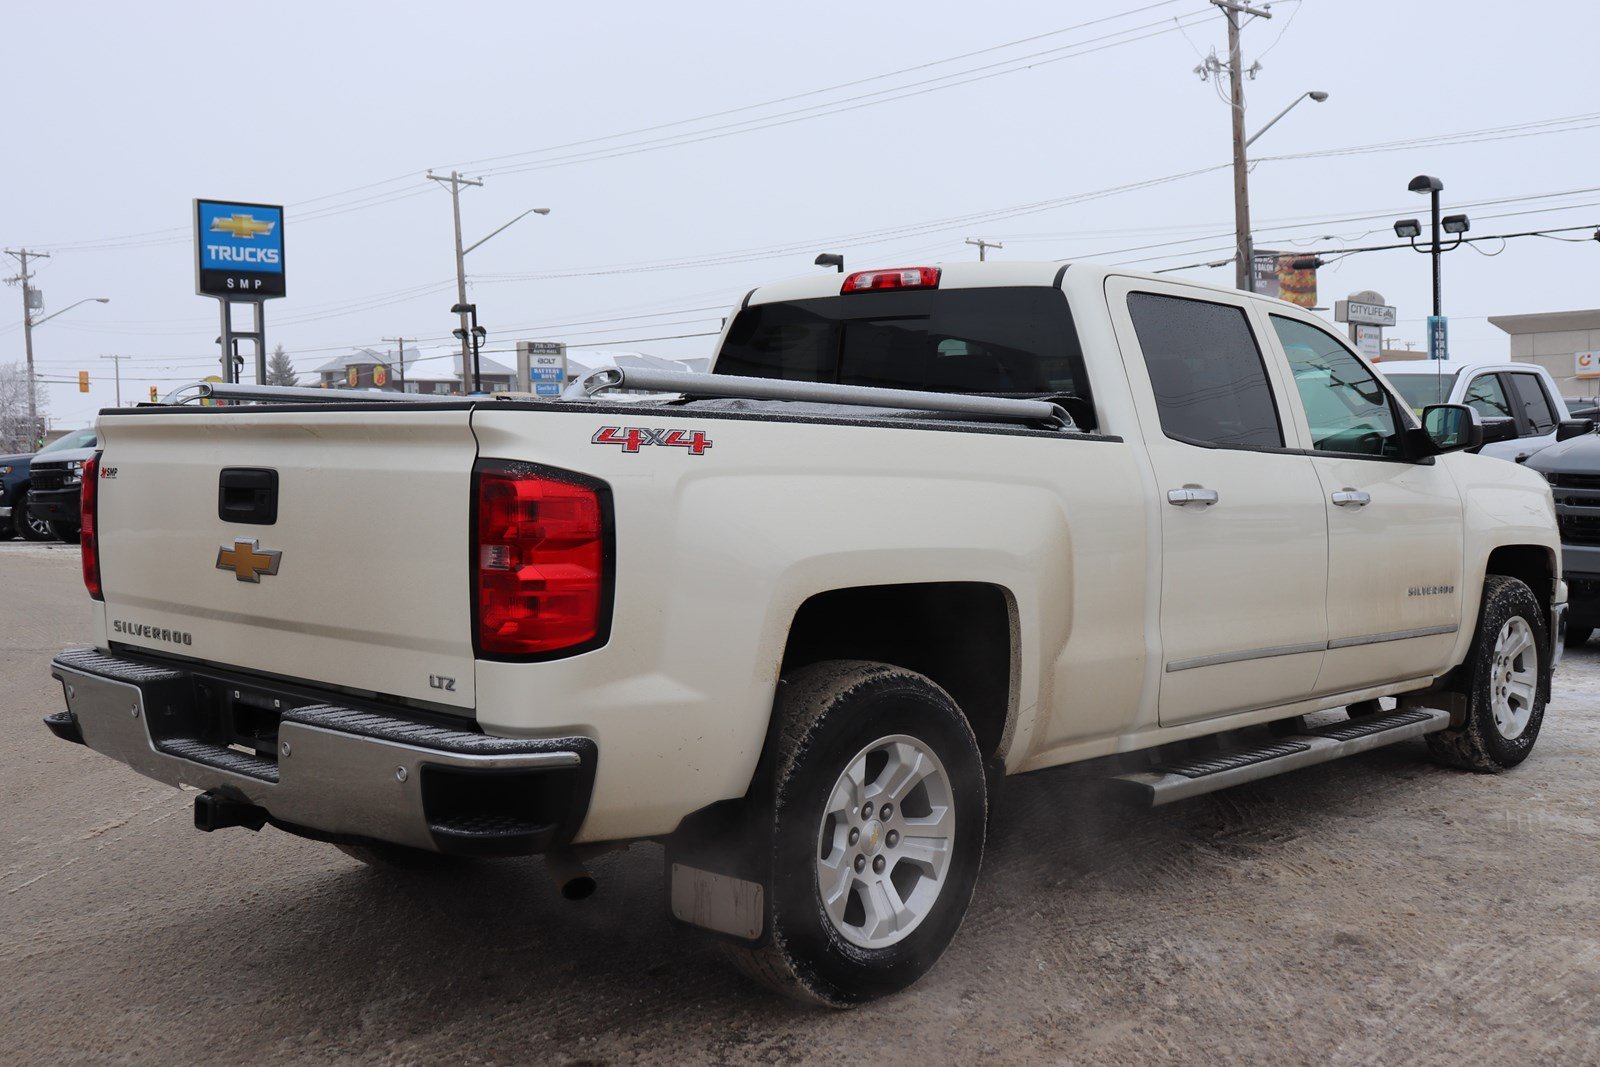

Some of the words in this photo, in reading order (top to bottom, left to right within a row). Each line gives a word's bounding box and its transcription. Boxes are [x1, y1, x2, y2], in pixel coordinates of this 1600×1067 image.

[207, 245, 279, 263] TRUCKS
[1350, 303, 1383, 317] CITYLIFE
[106, 467, 119, 476] SMP
[1408, 585, 1454, 597] SILVERADO
[113, 619, 192, 645] SILVERADO
[429, 675, 456, 691] LTZ
